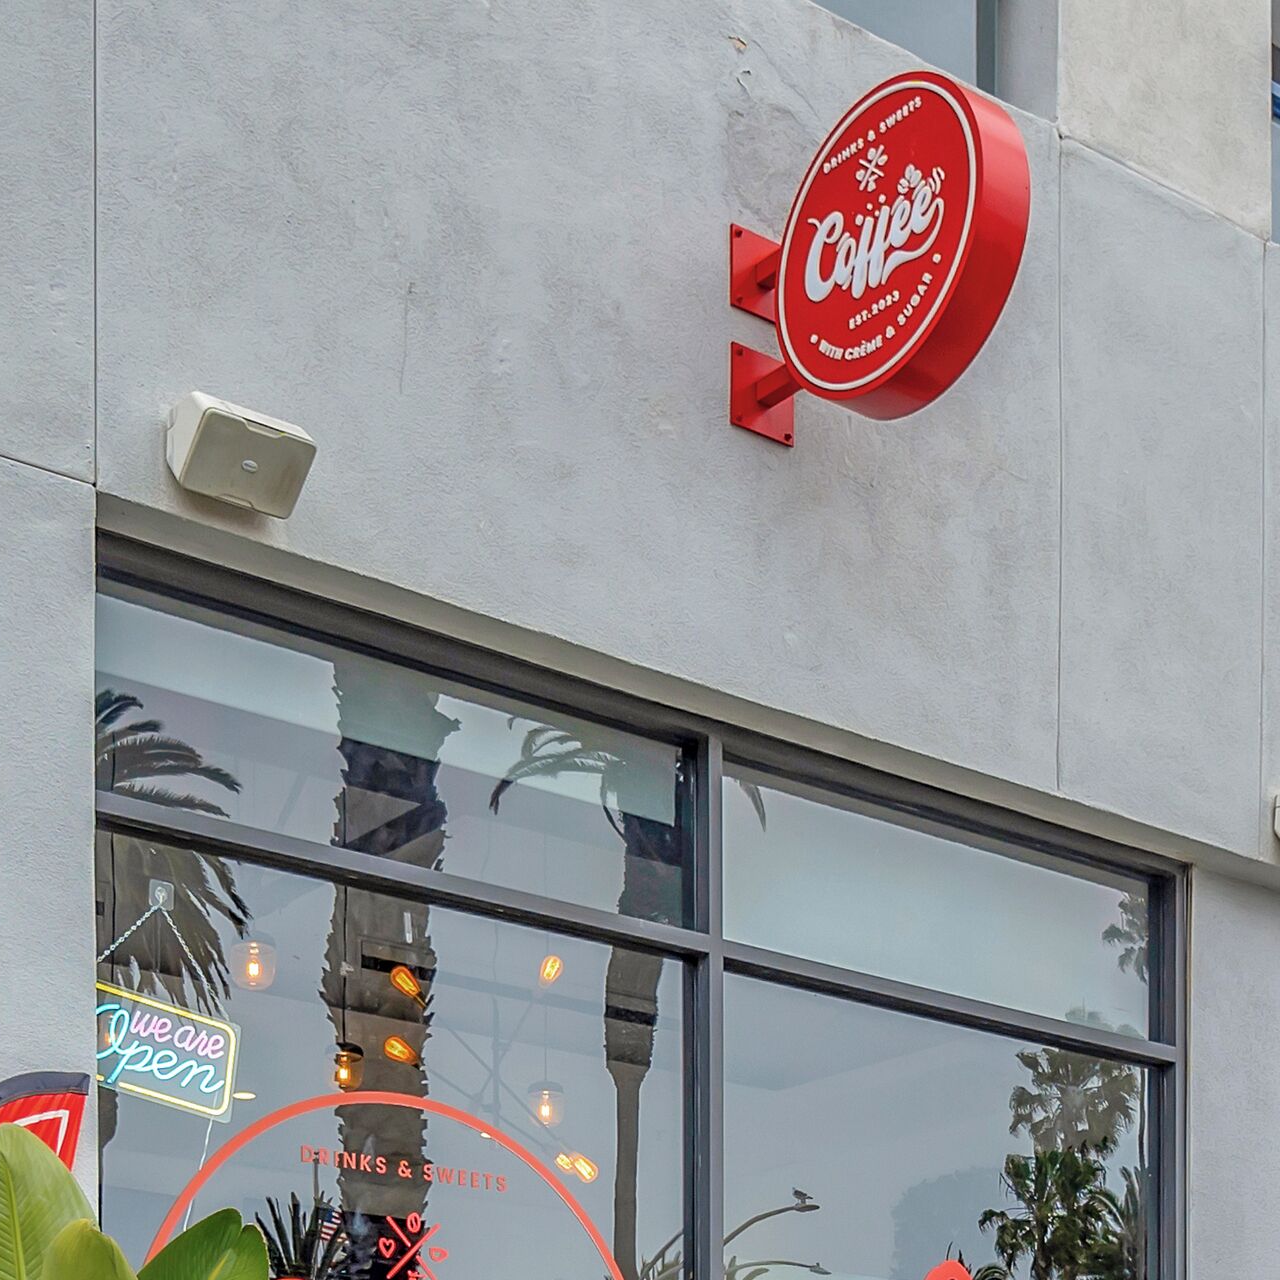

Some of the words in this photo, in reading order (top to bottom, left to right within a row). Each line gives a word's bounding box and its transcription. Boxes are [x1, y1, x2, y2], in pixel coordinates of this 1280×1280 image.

[823, 137, 864, 174] DRINKS
[879, 95, 921, 133] SWEETS
[805, 184, 944, 302] Coffee
[897, 272, 933, 326] SUGAR
[129, 1010, 173, 1043] we
[173, 1025, 225, 1060] are
[300, 1145, 388, 1175] DRINKS
[397, 1160, 413, 1180] &
[423, 1163, 509, 1193] SWEETS
